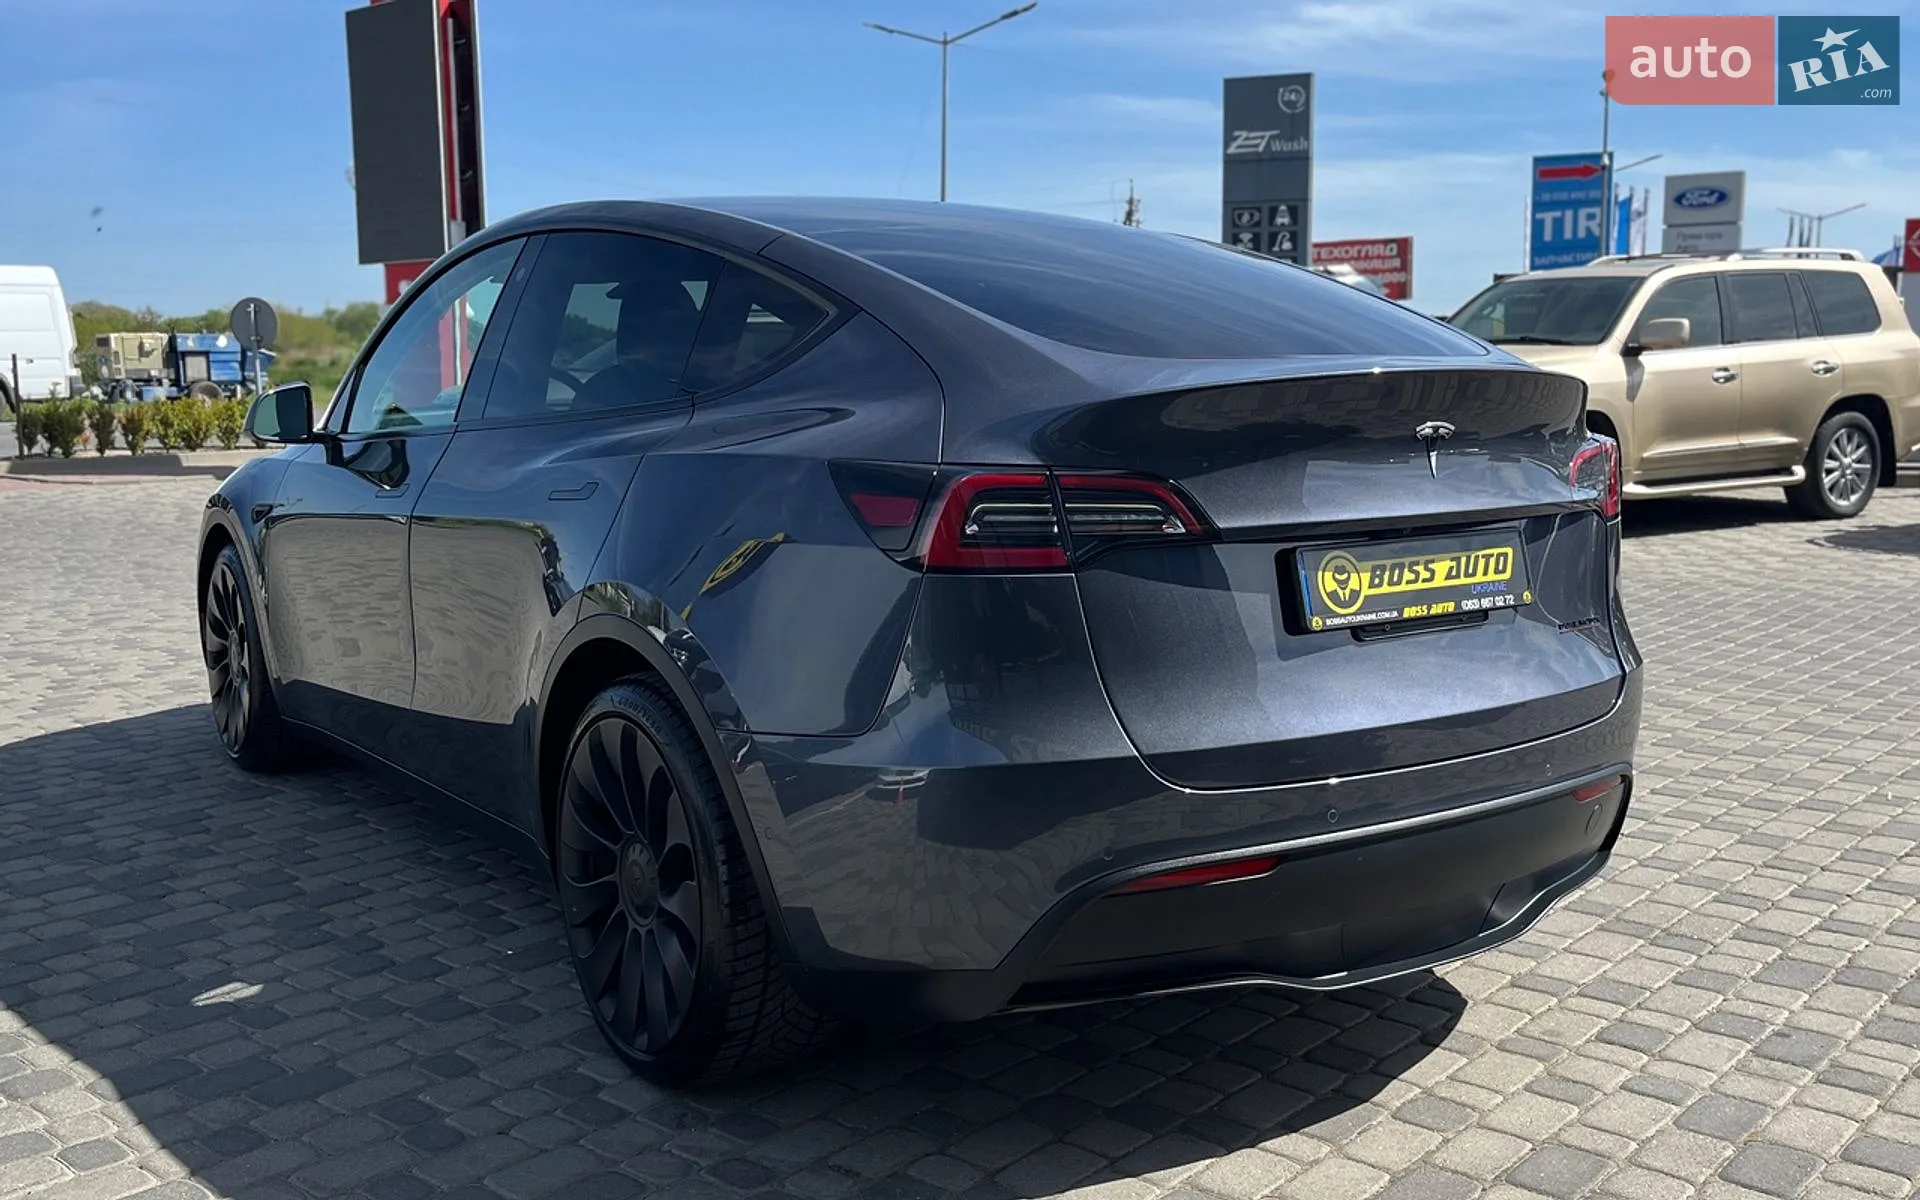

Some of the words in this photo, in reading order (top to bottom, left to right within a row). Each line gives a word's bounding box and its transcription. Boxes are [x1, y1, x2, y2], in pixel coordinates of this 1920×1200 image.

[1270, 136, 1308, 152] Wash
[1681, 189, 1720, 206] Ford
[1535, 207, 1602, 242] TIR
[1368, 560, 1437, 588] BOSS
[1443, 551, 1509, 580] AUTO
[1471, 580, 1508, 594] UKRAINE
[1402, 604, 1428, 618] BOSS
[1430, 601, 1456, 615] AUTO
[1505, 594, 1515, 605] 72
